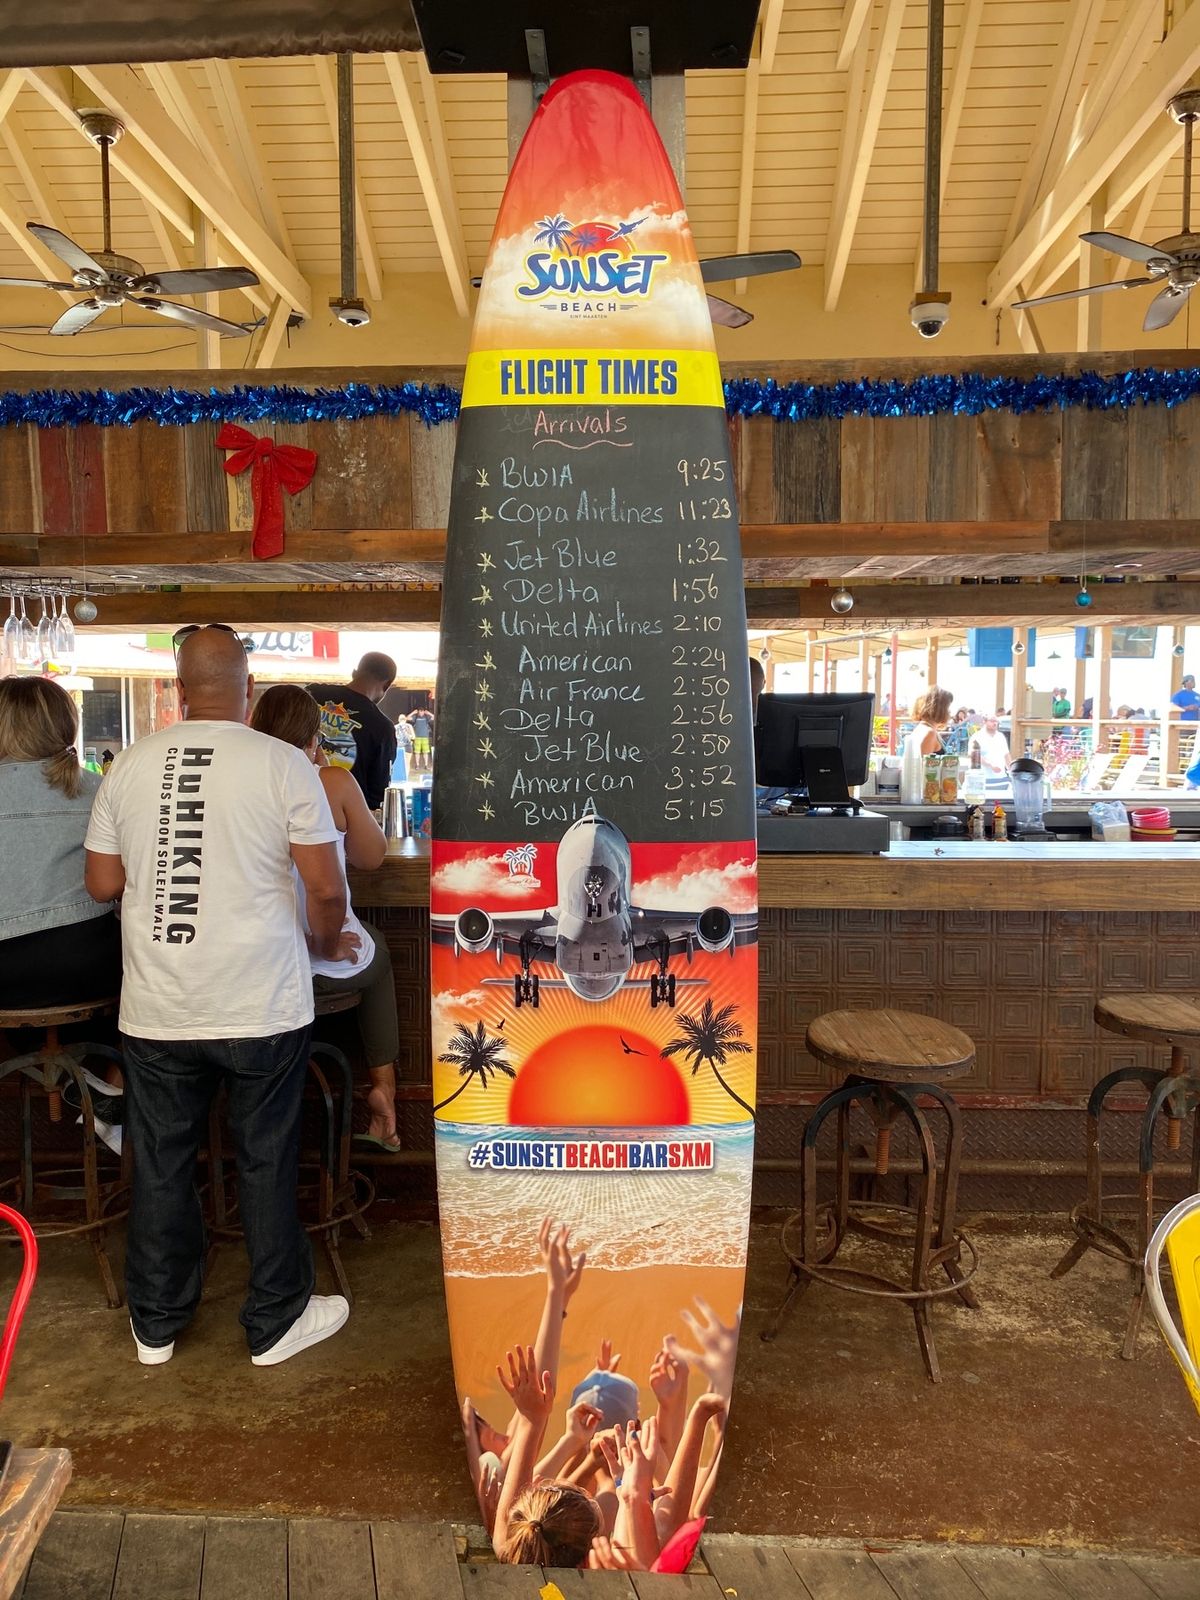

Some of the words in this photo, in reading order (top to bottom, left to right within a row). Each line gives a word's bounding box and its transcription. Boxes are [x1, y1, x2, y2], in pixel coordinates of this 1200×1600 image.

[517, 252, 668, 297] SUNSET
[560, 302, 616, 312] BEACH
[500, 359, 588, 395] FLIGHT
[598, 359, 678, 396] TIMES
[534, 408, 628, 437] Arrivals
[677, 457, 727, 487] 9:25
[498, 497, 569, 538] Copa
[576, 487, 663, 524] Airlines
[678, 497, 732, 521] 11:23
[677, 537, 728, 565] 1:32
[502, 577, 600, 605] Delta
[673, 573, 719, 604] 1:56
[501, 610, 578, 639] United
[584, 600, 663, 637] Airlines
[672, 614, 722, 632] 2:10
[518, 644, 632, 673] American
[671, 645, 726, 671] 2:24
[519, 678, 558, 704] Air
[565, 678, 646, 702] France
[672, 675, 731, 697] 2:50
[499, 706, 595, 732] Delta
[671, 699, 734, 725] 2:56
[160, 747, 178, 800] CLOUDS
[664, 764, 736, 790] 3:52
[158, 804, 171, 845] MOON
[664, 798, 724, 820] 5:15
[155, 850, 168, 900] SOLEIL
[152, 904, 164, 943] WALK
[470, 1141, 712, 1169] #SUNSETBEACHBARSXM
